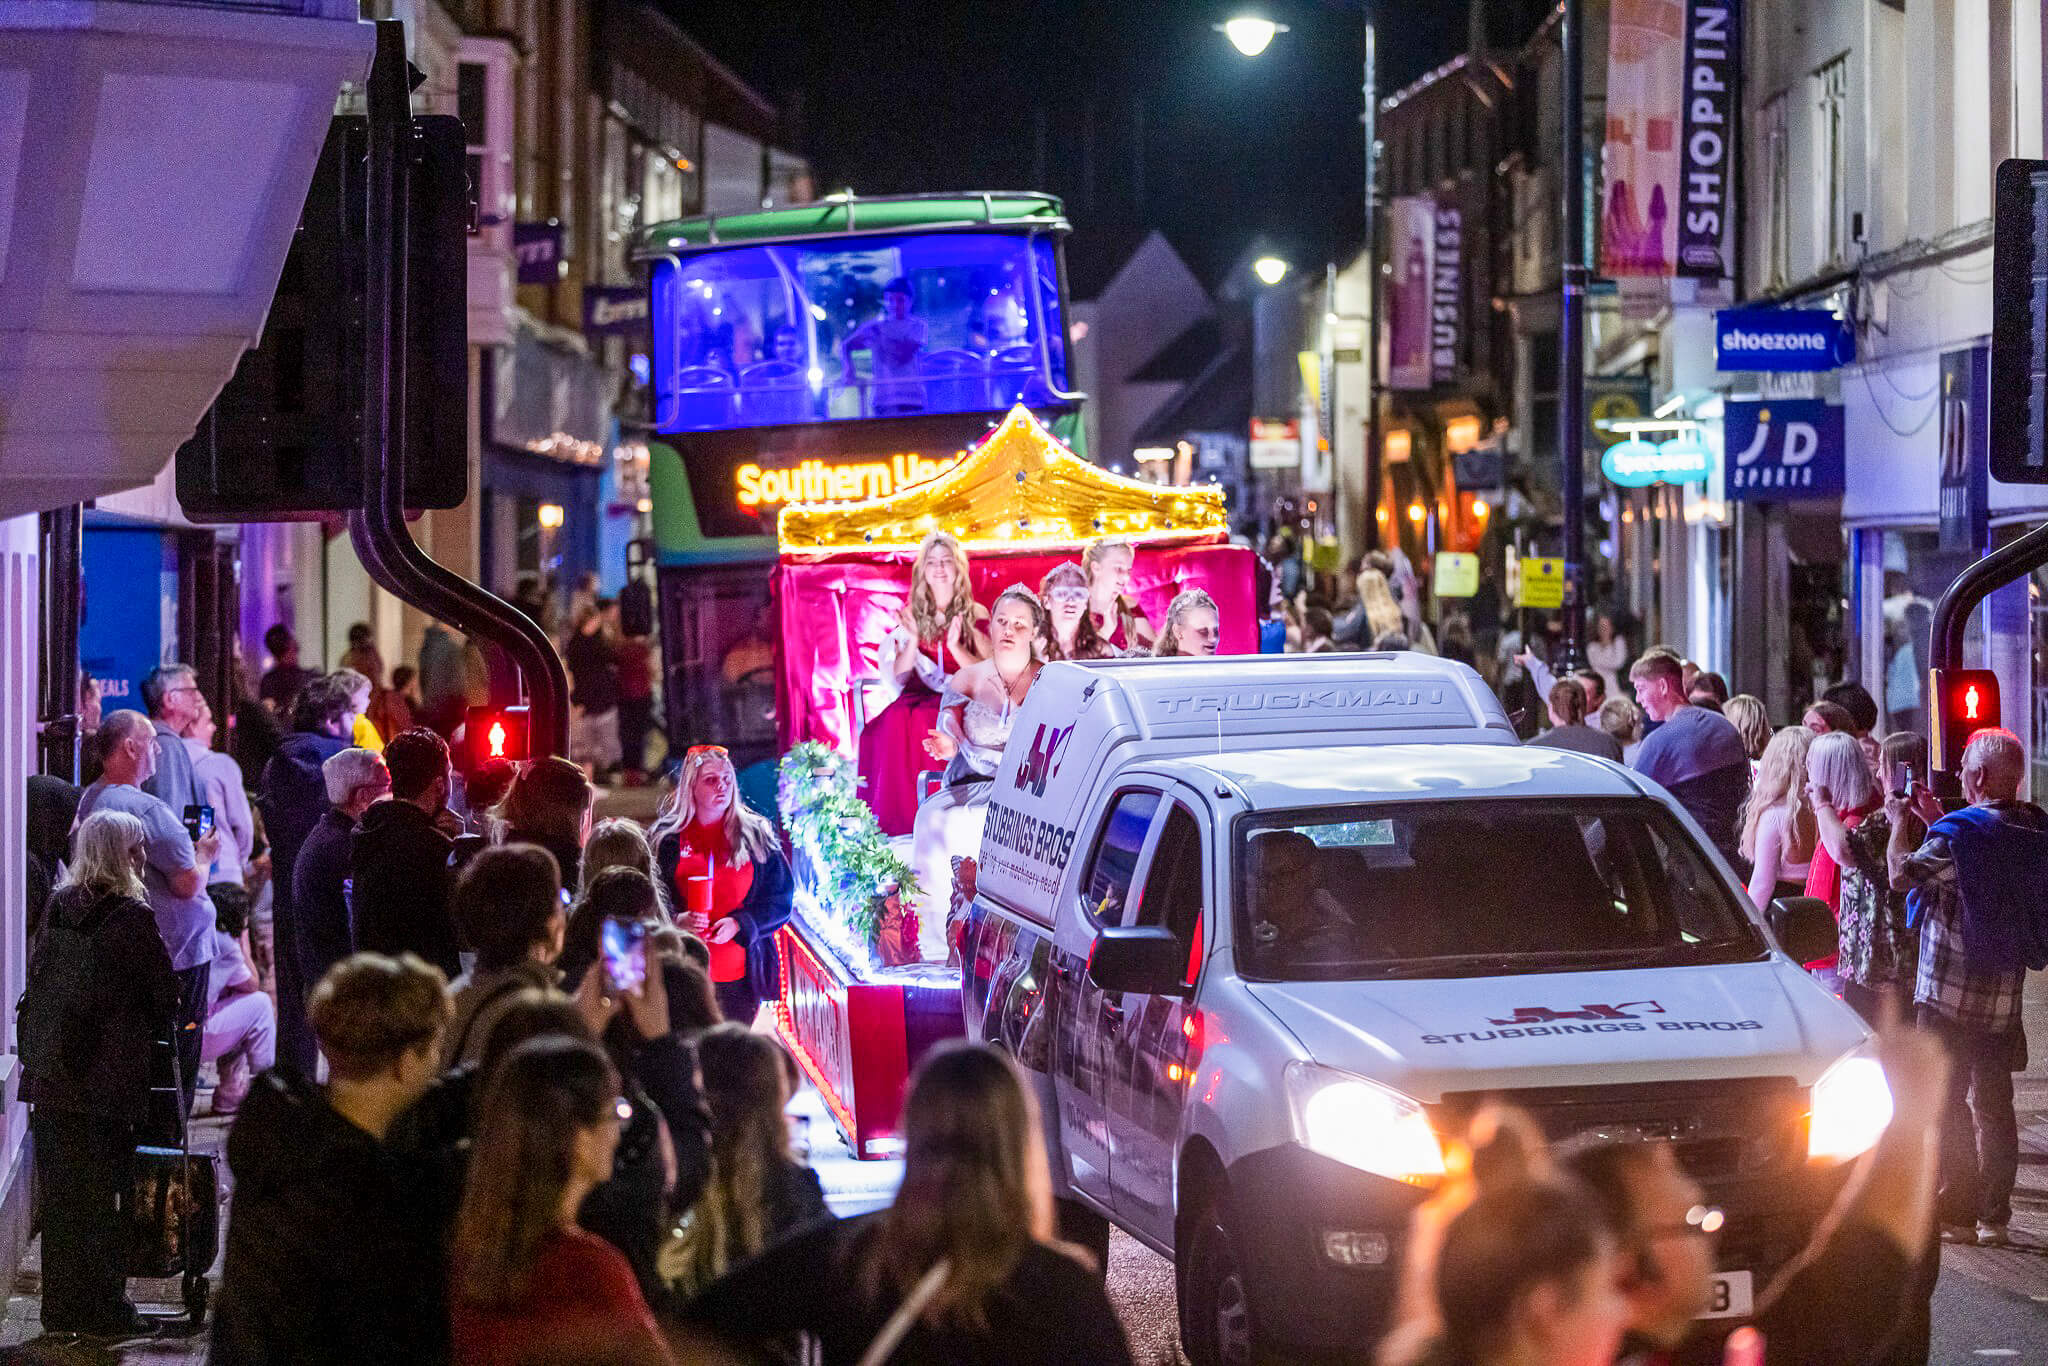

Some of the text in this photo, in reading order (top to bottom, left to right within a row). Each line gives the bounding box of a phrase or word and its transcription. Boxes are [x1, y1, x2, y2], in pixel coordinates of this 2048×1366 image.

[1686, 7, 1728, 235] SHOPPIN
[1432, 208, 1462, 367] BUSINESS
[1722, 328, 1826, 350] shoezone
[737, 459, 892, 504] Southern
[1734, 467, 1812, 487] SPORTS
[98, 679, 129, 696] EALS
[1157, 688, 1444, 714] TRUCKMAN
[983, 800, 1076, 870] STUBBINGS BROS
[1421, 1019, 1764, 1045] STUBBINGS BROS
